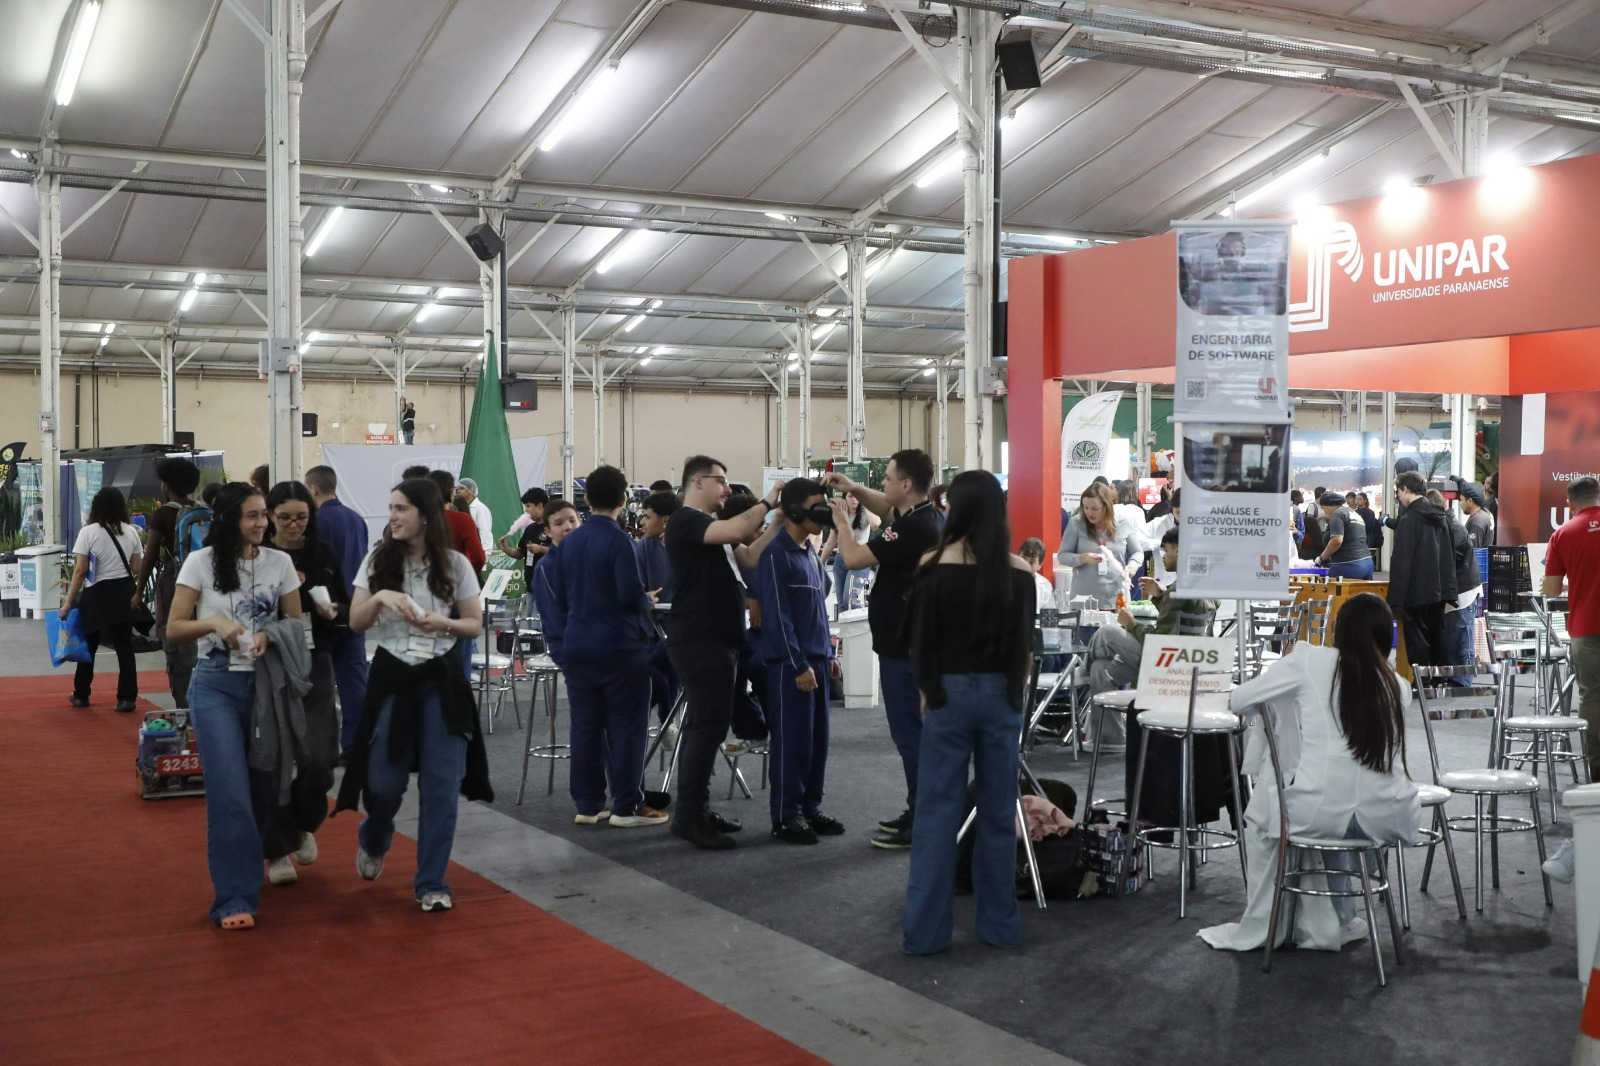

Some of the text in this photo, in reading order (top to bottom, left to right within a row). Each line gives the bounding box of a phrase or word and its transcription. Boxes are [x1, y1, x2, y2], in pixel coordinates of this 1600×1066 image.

[1373, 234, 1509, 286] UNIPAR
[1372, 277, 1510, 303] UNIVERSIDADE PARANAENSE
[1191, 334, 1273, 345] ENGENHARIA
[1188, 350, 1276, 361] DE SOFTWARE
[1210, 505, 1260, 516] ANÁLISE E
[1187, 516, 1282, 527] DESENVOLVIMENTO
[1203, 527, 1266, 537] DE SISTEMAS
[1148, 677, 1220, 687] DESENVOLVMENTO
[162, 757, 199, 771] 3243
